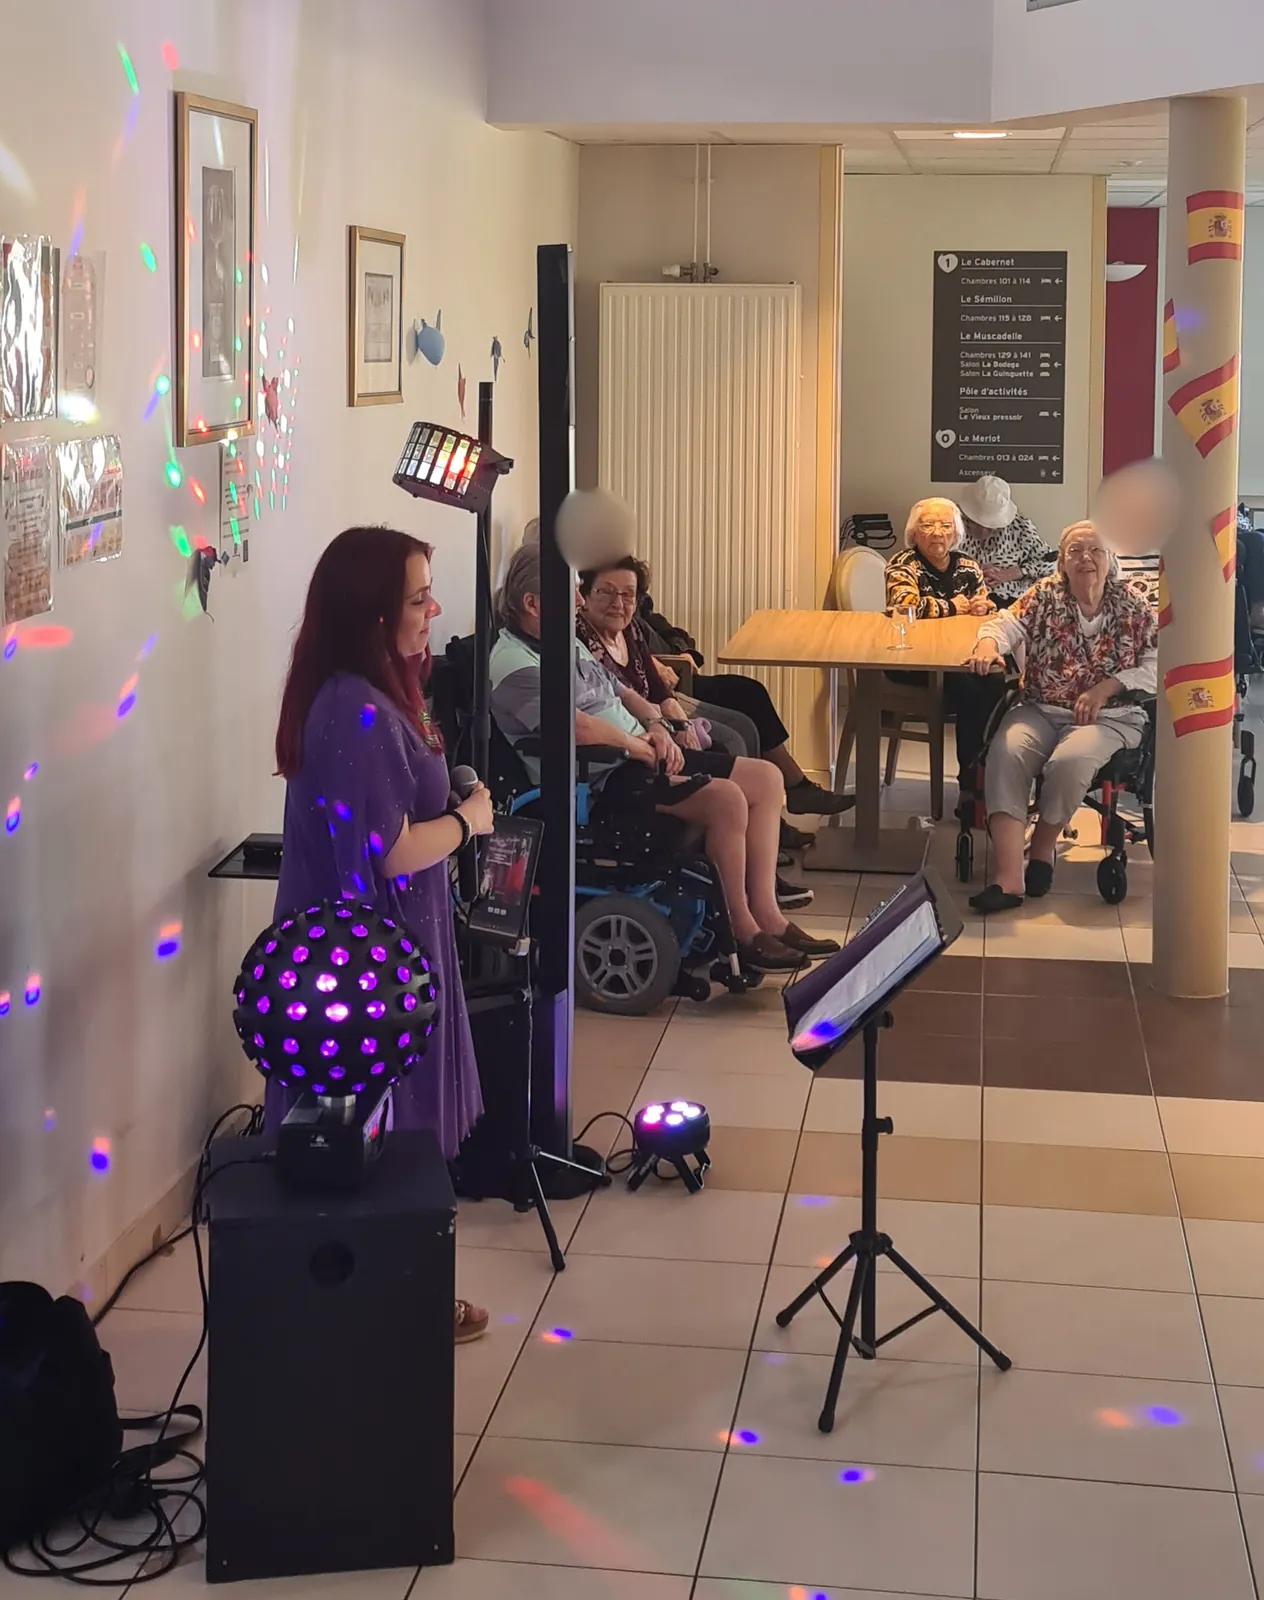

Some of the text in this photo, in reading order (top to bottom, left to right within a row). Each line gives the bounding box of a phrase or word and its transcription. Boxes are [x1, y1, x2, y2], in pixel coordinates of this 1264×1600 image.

[945, 258, 951, 268] 1
[961, 258, 1015, 266] Le Cabernet
[960, 294, 1012, 303] Le Sémillon
[960, 332, 1023, 340] Le Muscadelle
[993, 361, 1020, 369] Bodega
[993, 370, 1034, 378] Guinguette
[960, 387, 1028, 396] Pôle d'activités
[993, 413, 1023, 421] pressoir
[972, 434, 1001, 442] Merlot
